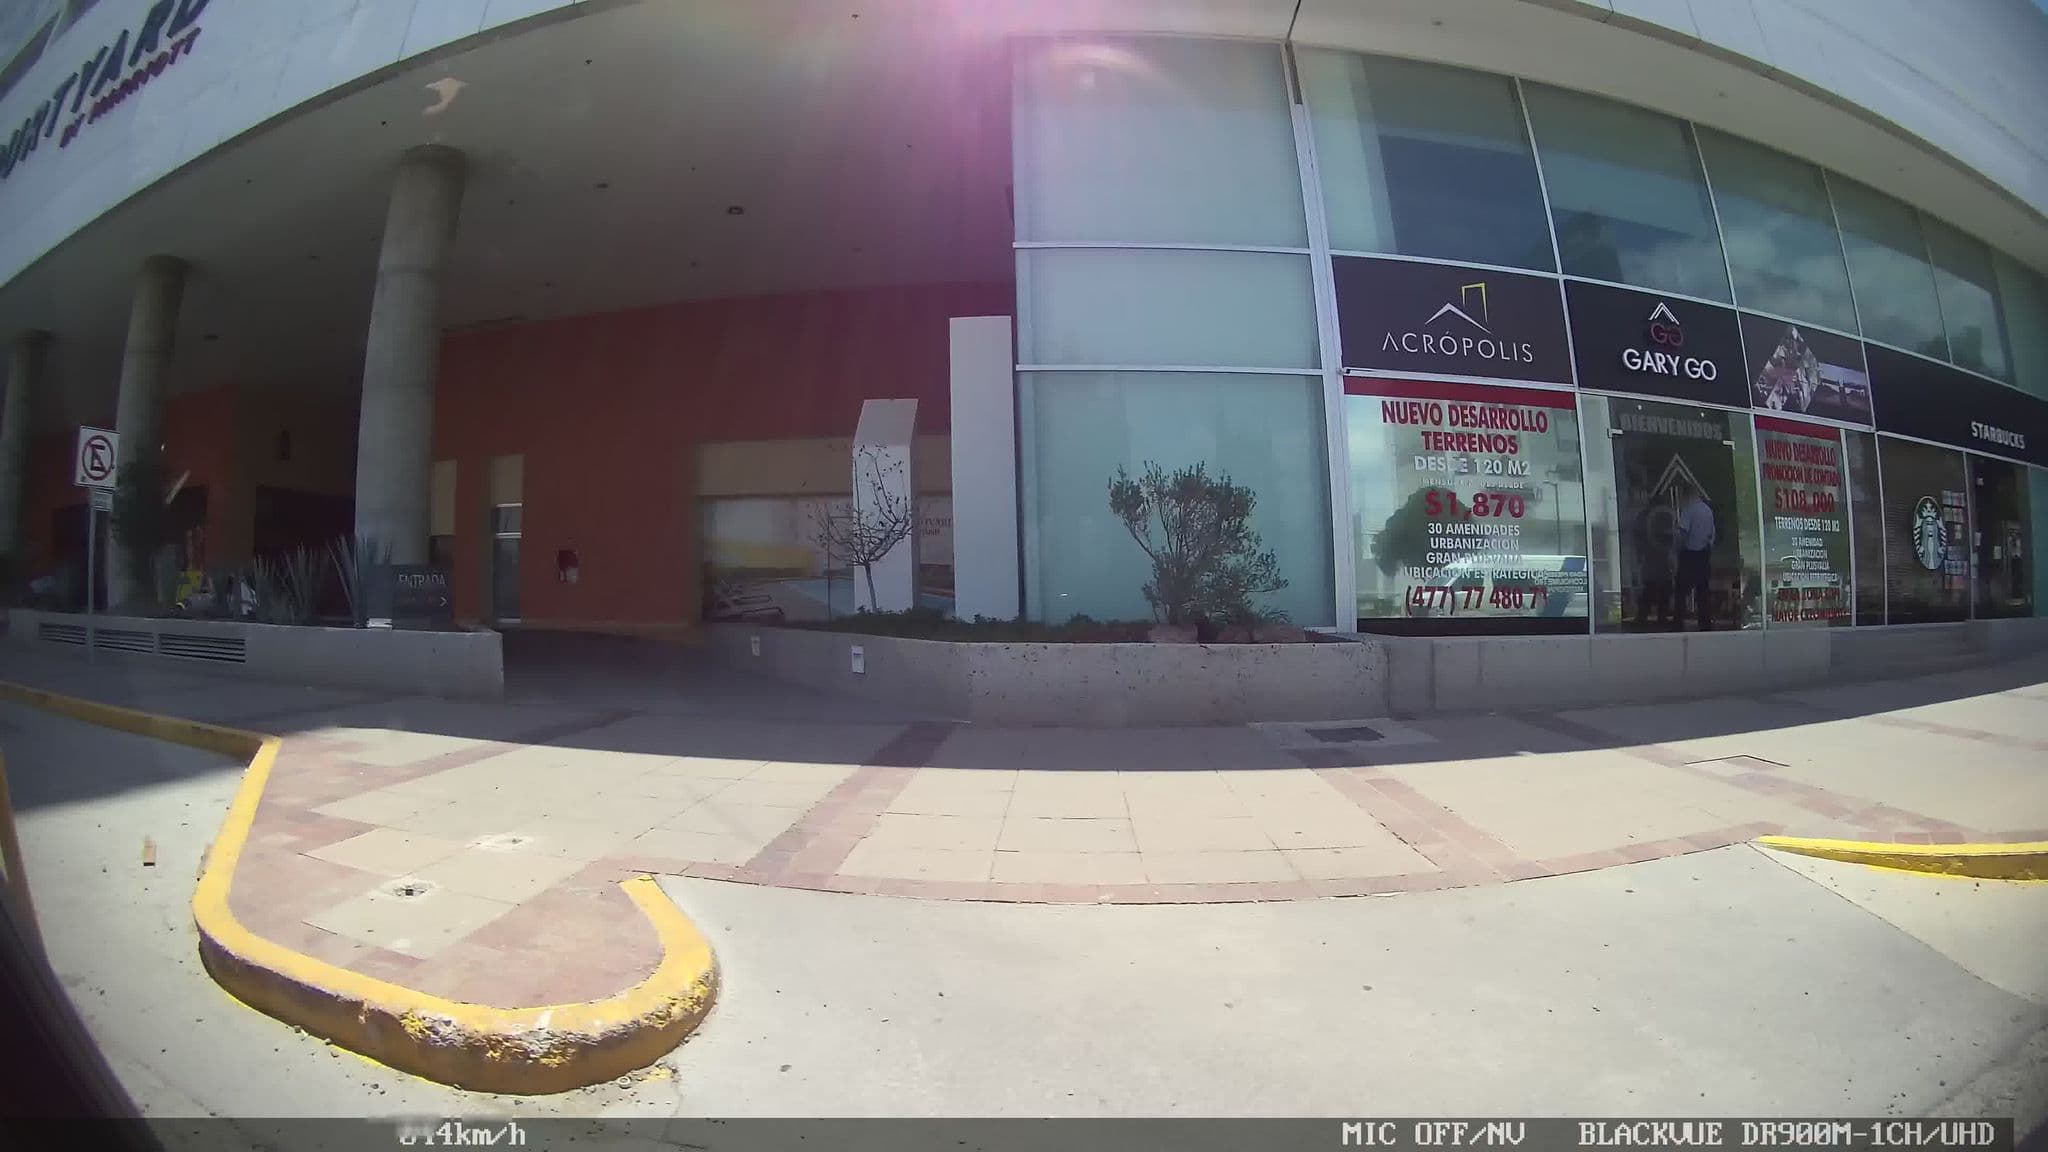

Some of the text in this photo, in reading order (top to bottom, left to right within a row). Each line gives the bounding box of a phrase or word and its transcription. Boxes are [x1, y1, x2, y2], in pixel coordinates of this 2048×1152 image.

[1382, 331, 1533, 363] ACRÓPOLIS
[1623, 348, 1717, 381] GARY GO
[1381, 400, 1548, 433] NUEVO DESARROLLO
[1421, 430, 1519, 455] TERRENOS
[1971, 421, 2025, 449] STARBUCKS
[1414, 455, 1532, 476] DESDE 120 M2
[1424, 489, 1526, 522] $1,870
[1428, 523, 1520, 537] 30 AMENIDADES
[1430, 537, 1520, 550] URBANIZACION
[1426, 552, 1464, 564] GRAN
[1405, 585, 1456, 616] (477)
[1463, 586, 1485, 609] 77
[1489, 586, 1523, 609] 480
